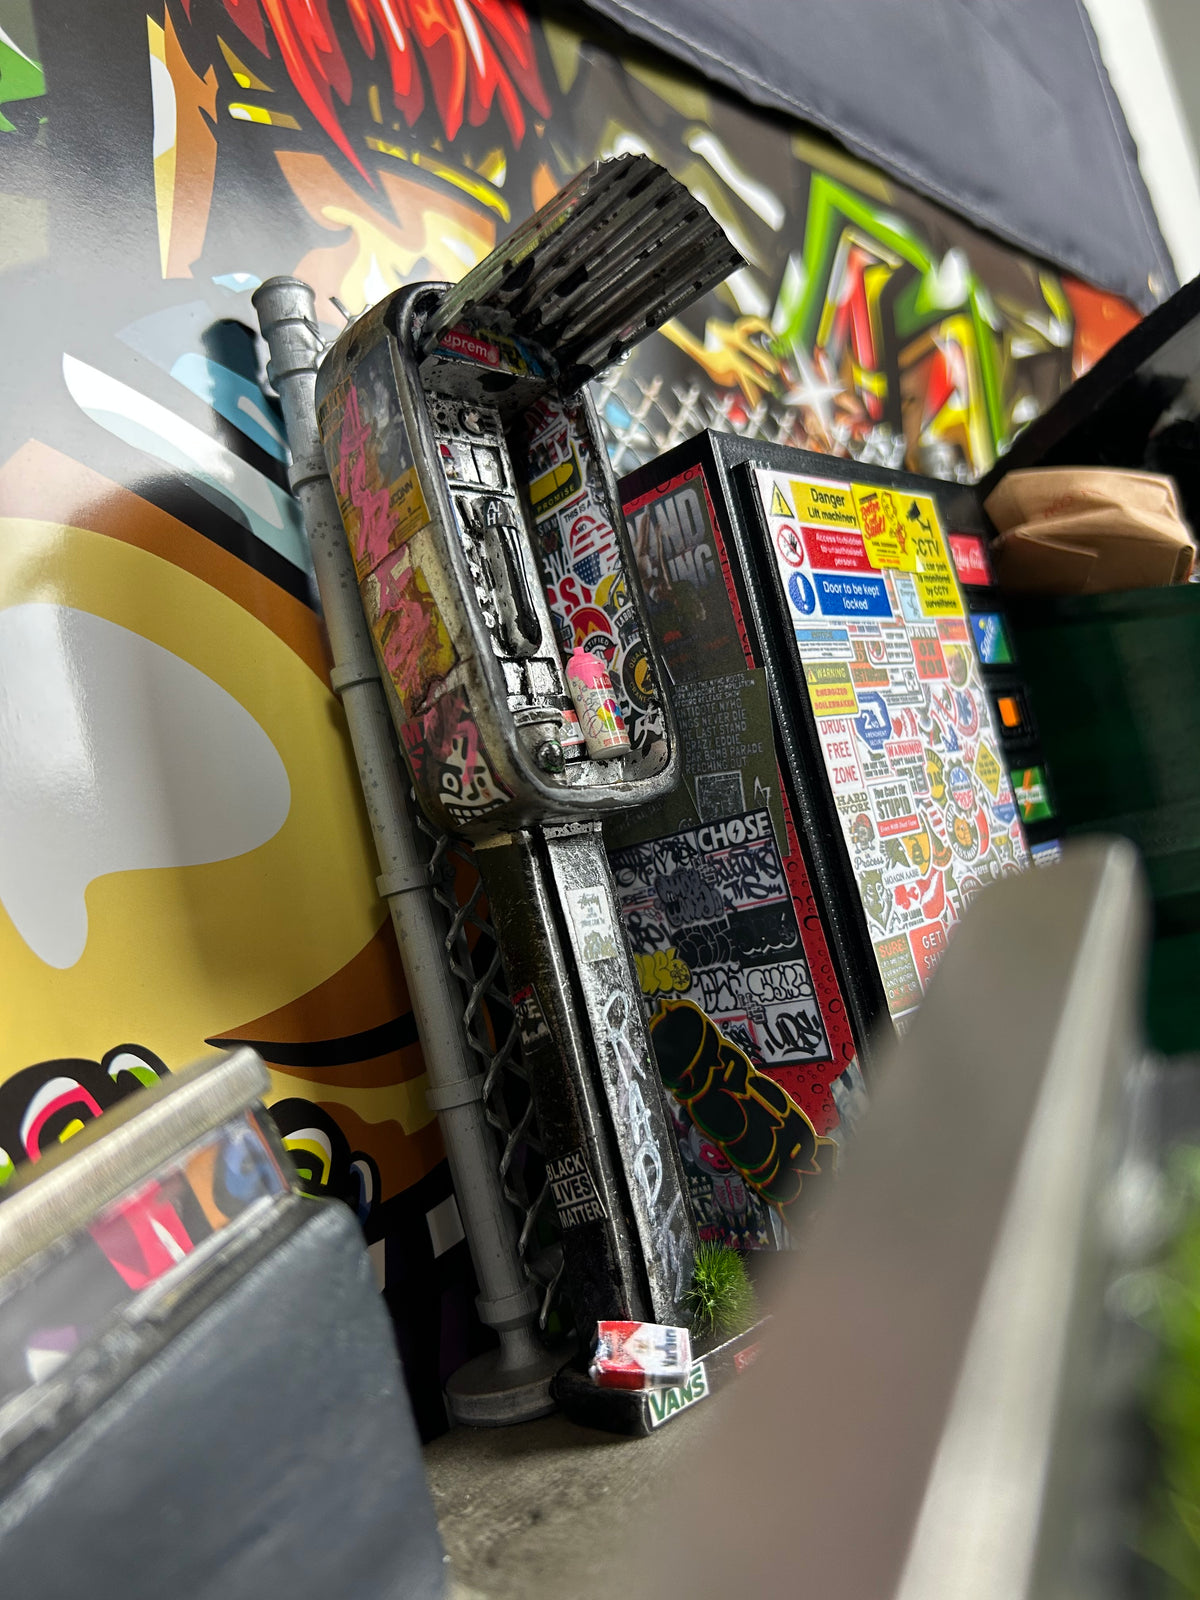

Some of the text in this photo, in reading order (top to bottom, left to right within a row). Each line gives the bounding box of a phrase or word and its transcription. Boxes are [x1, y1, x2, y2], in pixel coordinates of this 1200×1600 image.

[810, 488, 845, 509] Danger
[564, 499, 592, 524] THIS IS A
[807, 506, 857, 527] Lift machinery
[816, 533, 835, 544] Access
[924, 574, 951, 584] monitored
[822, 581, 881, 599] Door to be kept
[933, 585, 949, 596] CCTV
[842, 597, 869, 611] locked
[584, 637, 610, 653] RTIFIED
[816, 667, 847, 679] WARNING
[919, 659, 944, 675] YOU
[725, 673, 745, 686] ROOTS
[698, 692, 724, 703] RELEASE
[701, 713, 730, 727] NEVER
[732, 709, 748, 721] DIE
[819, 718, 846, 736] DRUG
[696, 726, 717, 739] LAST
[719, 722, 747, 735] STAND
[715, 734, 741, 747] EDDIE
[685, 742, 763, 765] CAR BOMB PARADE
[826, 741, 852, 761] FREE
[685, 757, 748, 774] REACHING OUT
[832, 765, 859, 785] ZONE
[836, 792, 868, 807] HARD
[873, 783, 907, 799] You Can't Fix
[838, 802, 871, 816] WORK
[876, 796, 912, 820] STUPID
[697, 811, 771, 853] CHOSE
[879, 939, 907, 958] SURE!
[922, 930, 943, 950] GET
[546, 1153, 585, 1182] BLACK
[552, 1175, 592, 1205] LIVES
[558, 1201, 603, 1230] MATTER
[650, 1366, 706, 1421] VANS
